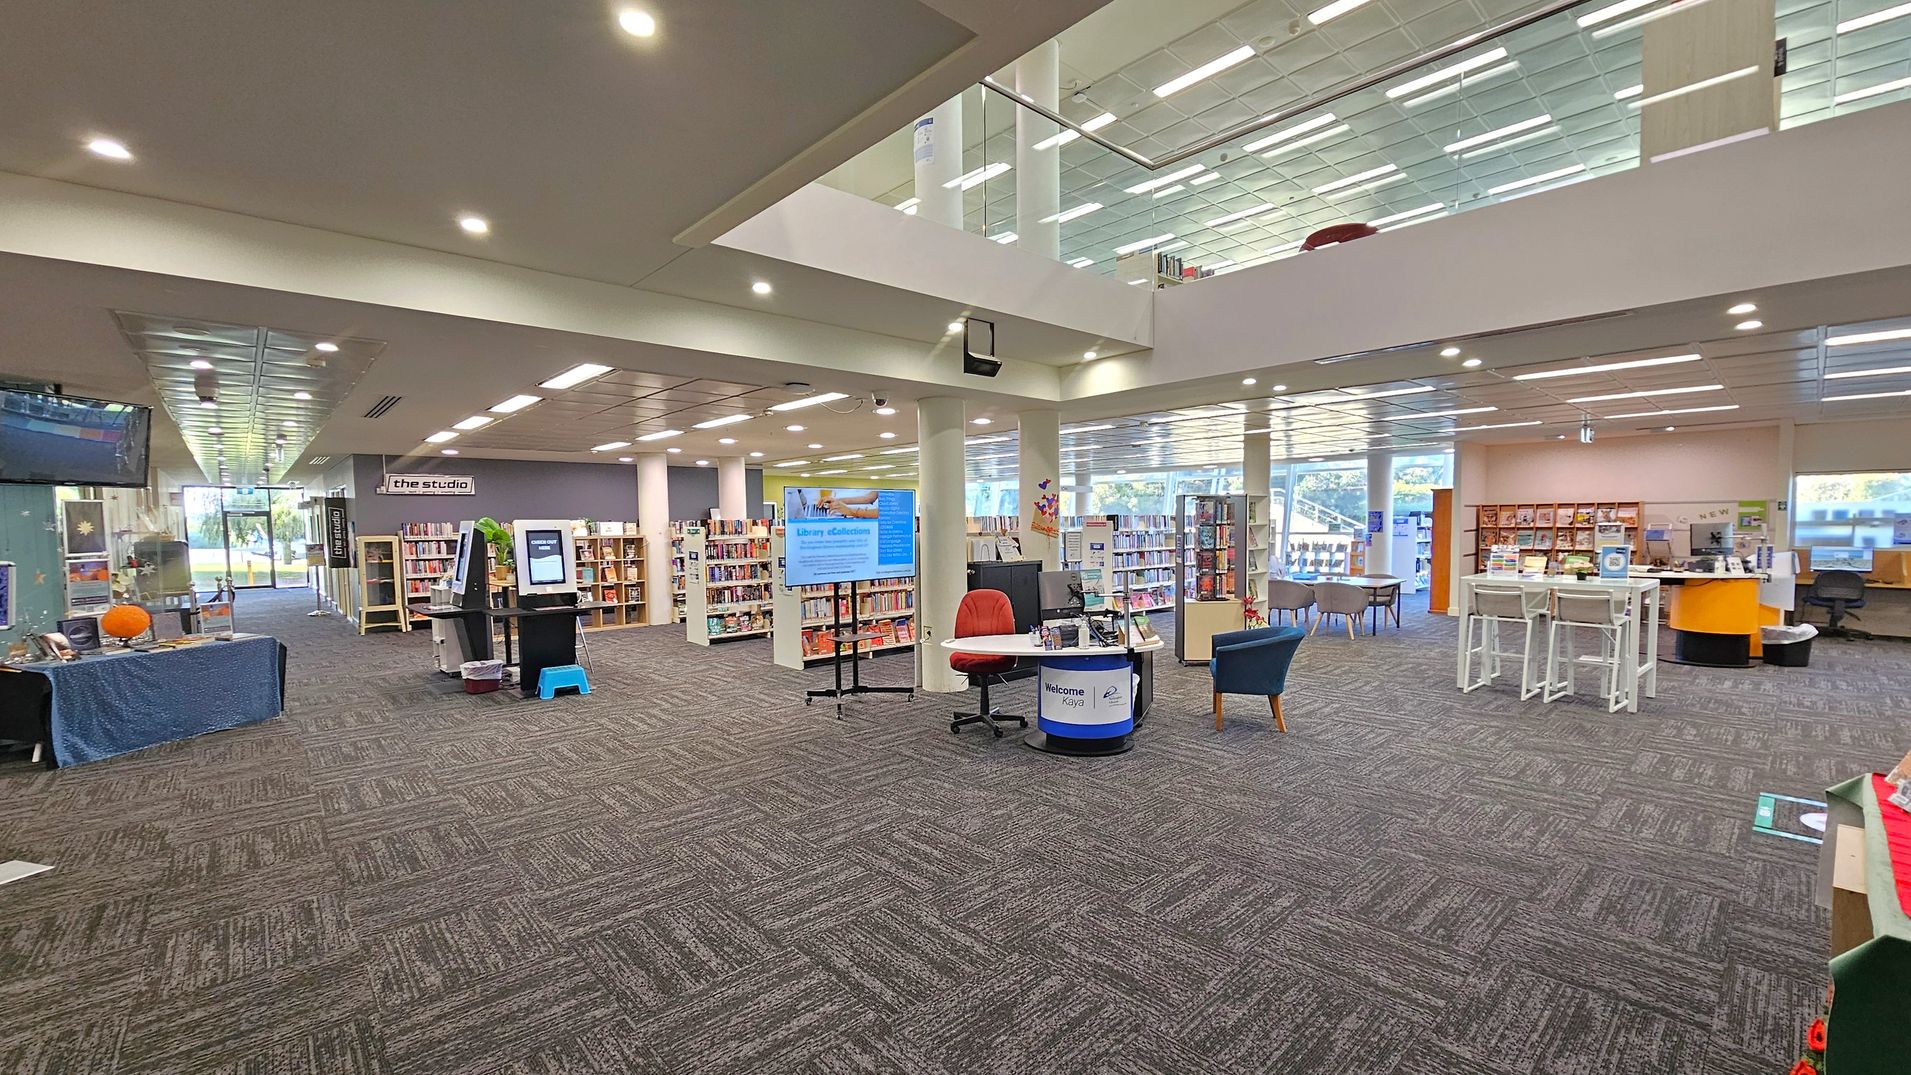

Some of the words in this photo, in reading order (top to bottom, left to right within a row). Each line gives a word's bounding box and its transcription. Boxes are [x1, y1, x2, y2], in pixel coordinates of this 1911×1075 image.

[394, 479, 420, 488] the
[422, 479, 468, 488] studio
[1699, 508, 1729, 519] NEW
[332, 511, 342, 539] studio
[797, 527, 824, 537] Library
[827, 527, 871, 536] eCollections
[333, 540, 343, 555] the
[1045, 682, 1085, 696] Welcome
[1062, 696, 1085, 709] Kaya
